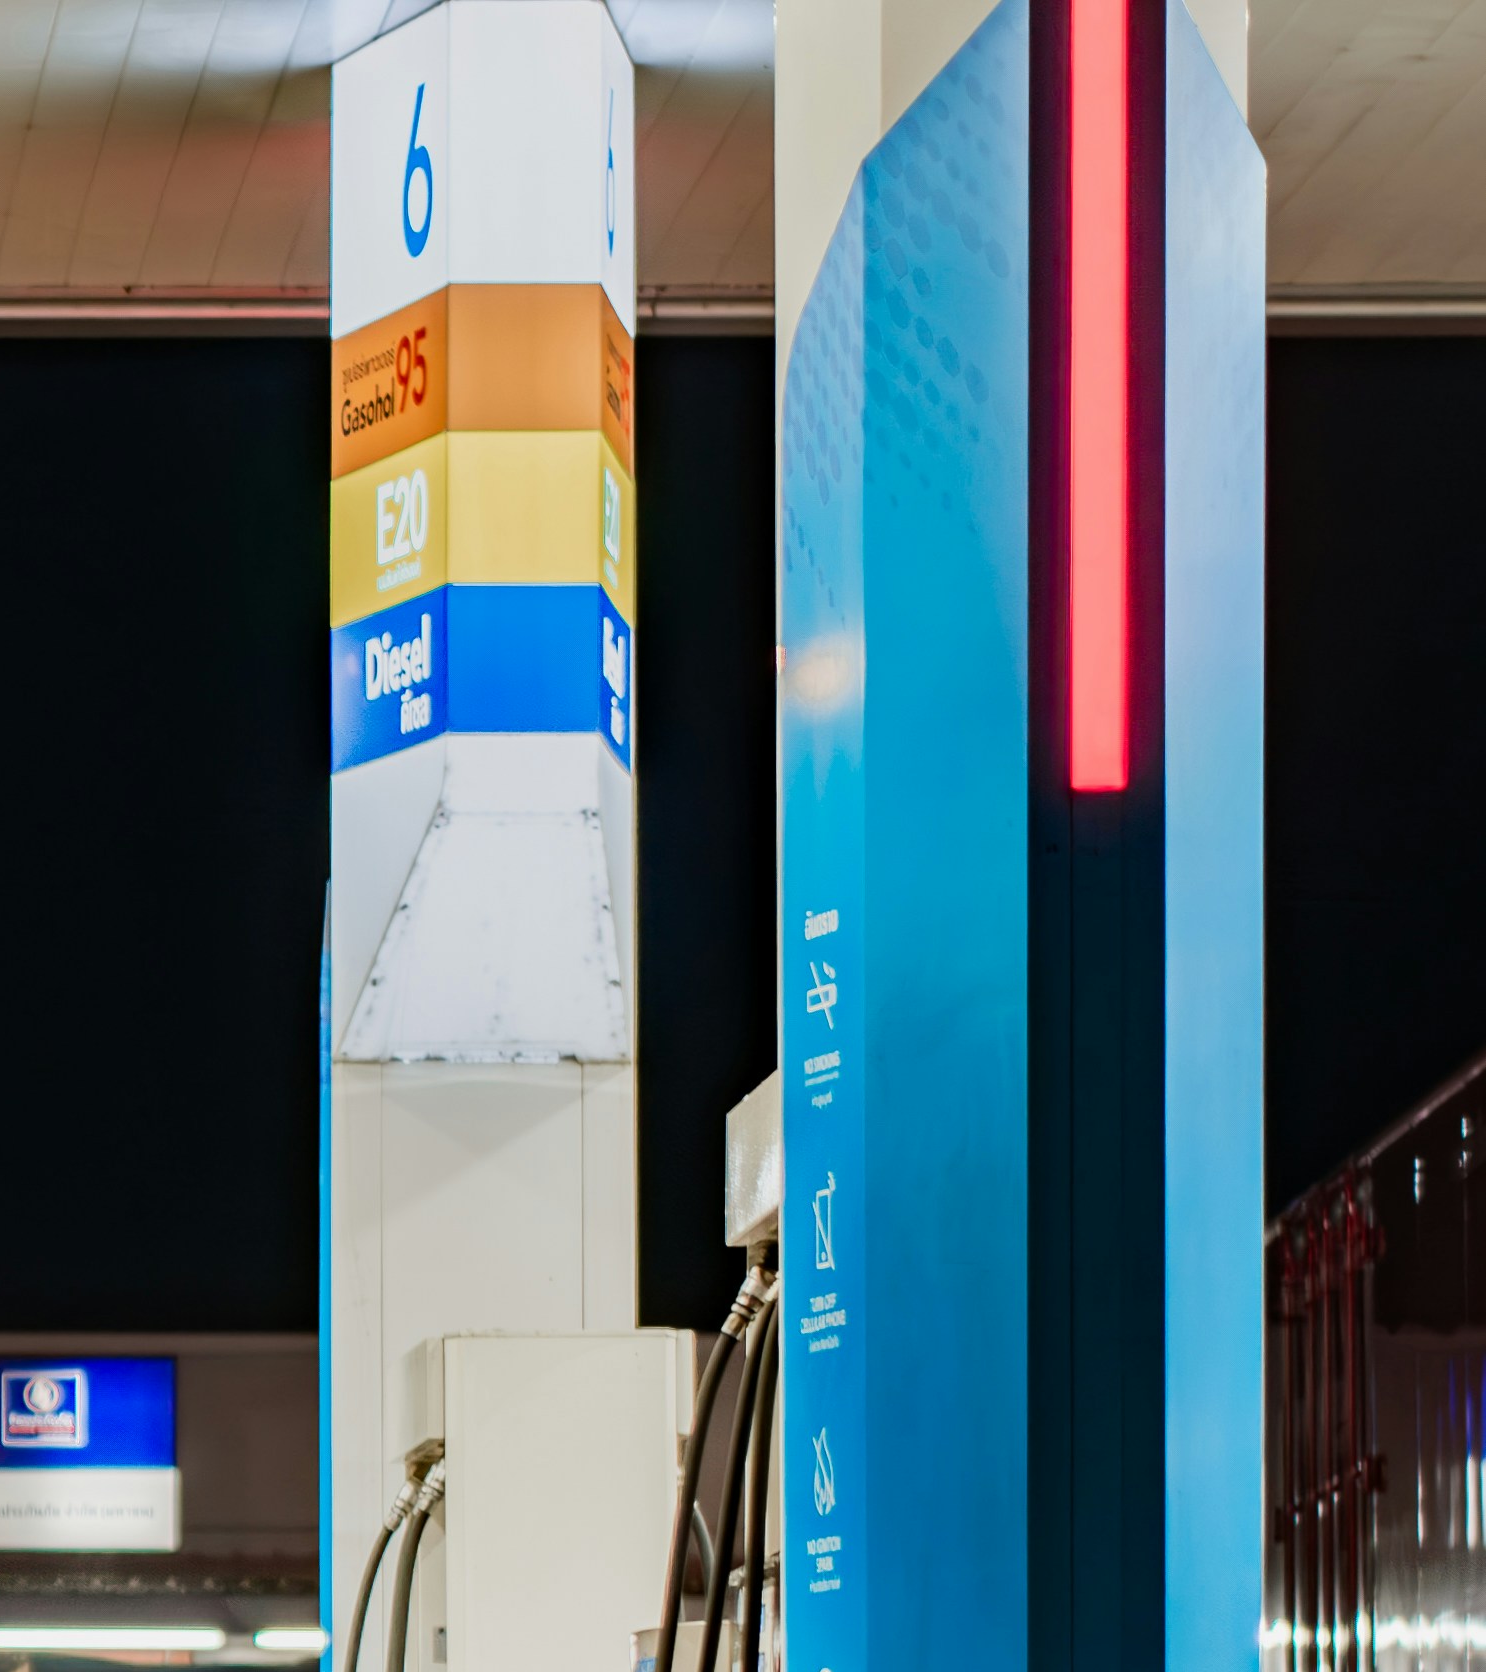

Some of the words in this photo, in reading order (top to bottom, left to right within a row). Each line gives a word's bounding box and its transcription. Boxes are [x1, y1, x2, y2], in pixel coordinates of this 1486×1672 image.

[403, 83, 432, 258] 6
[341, 376, 395, 437] Gasohol
[396, 326, 428, 414] 95
[376, 469, 428, 566] E20
[365, 613, 432, 702] Diesel
